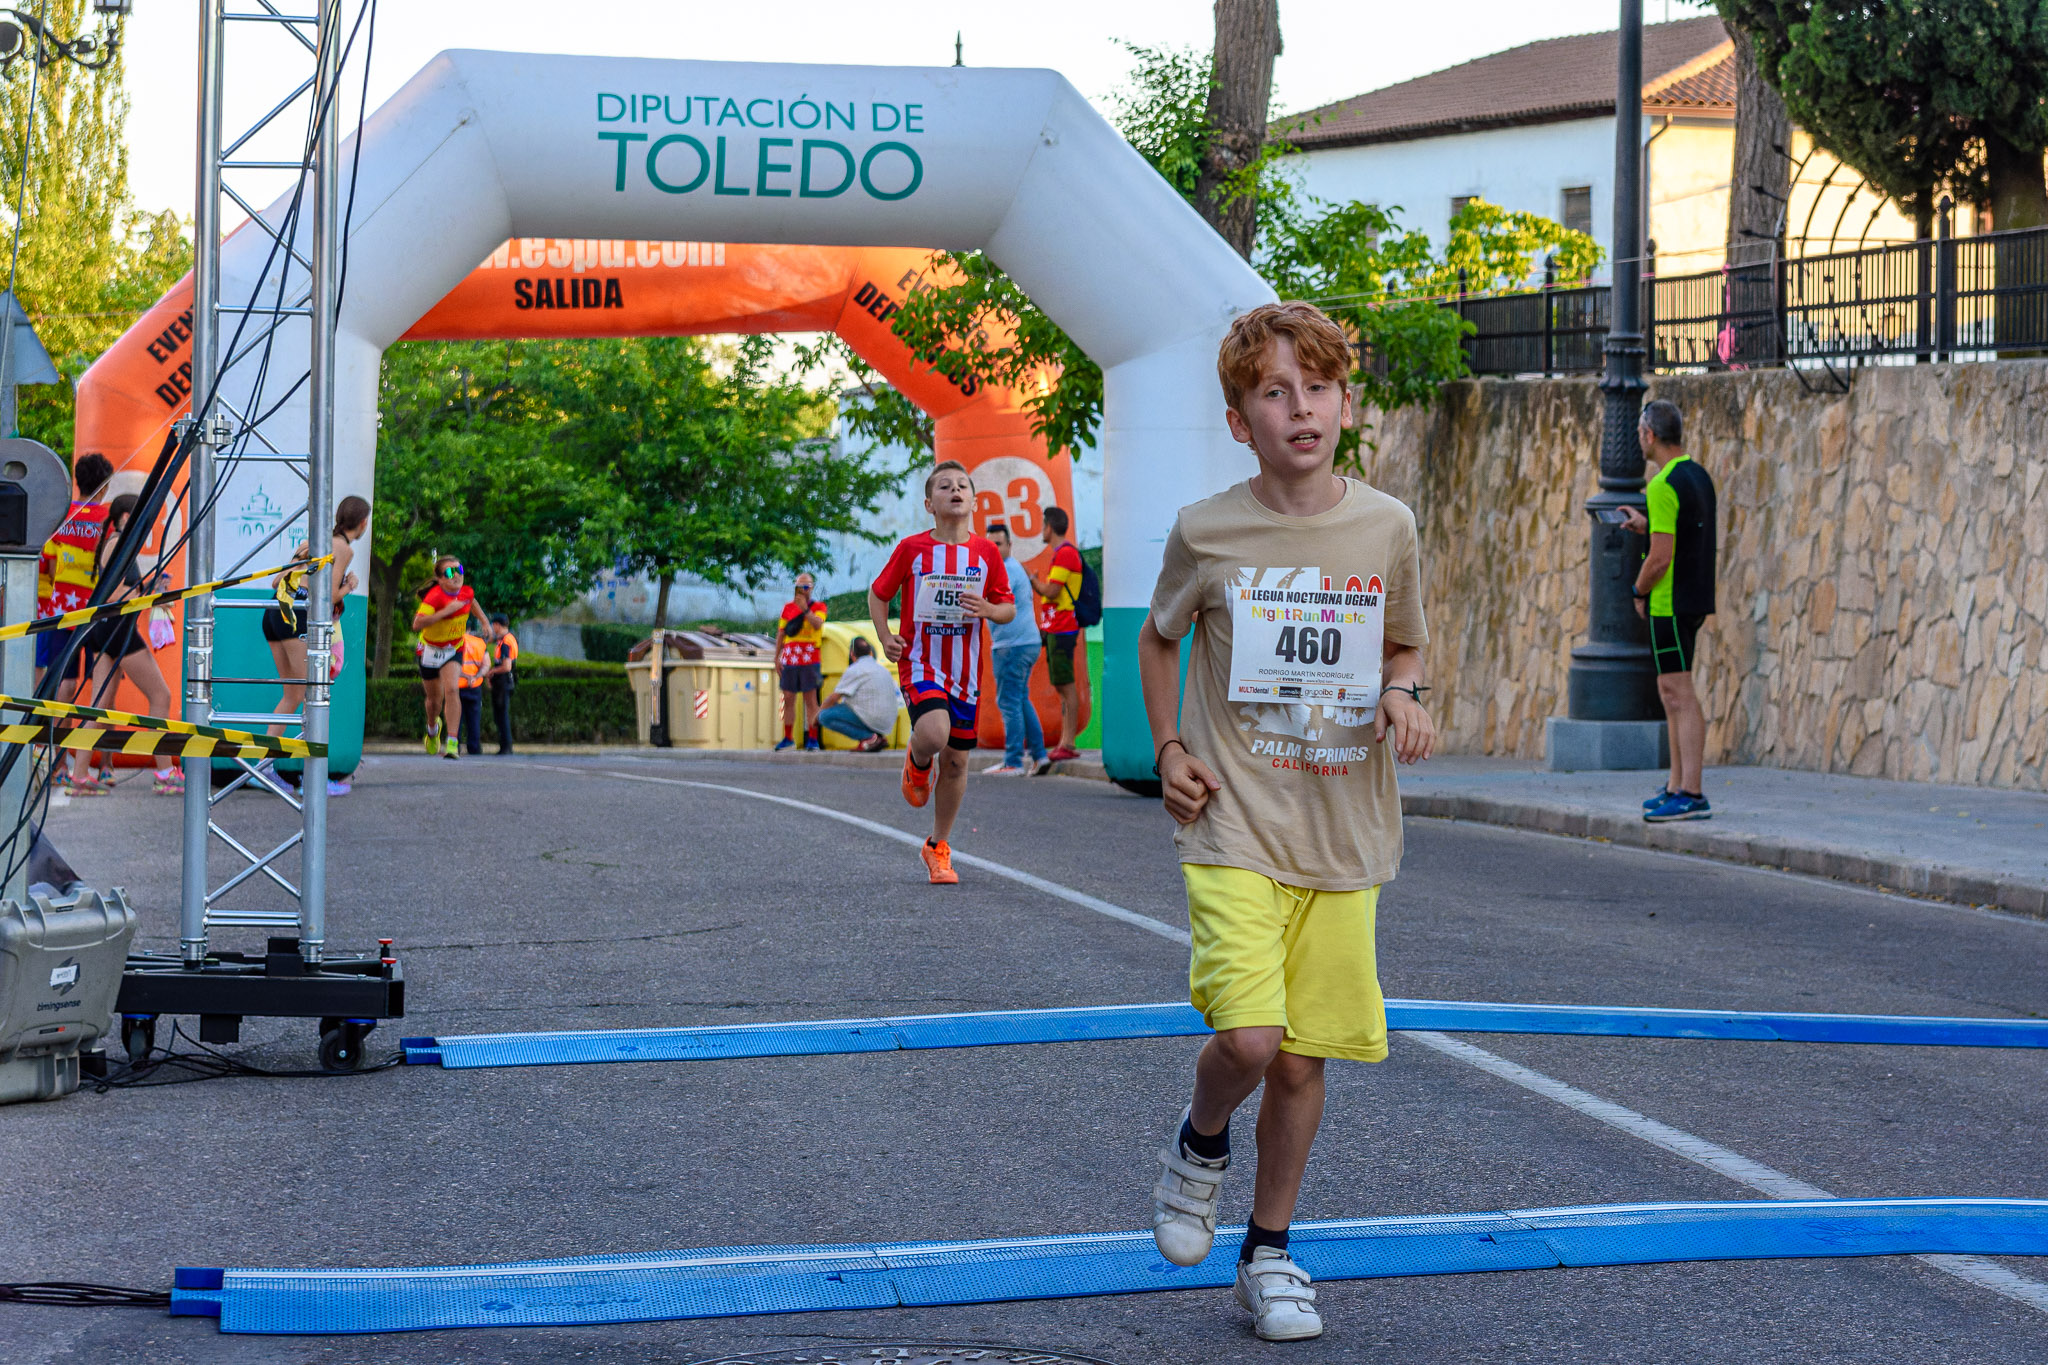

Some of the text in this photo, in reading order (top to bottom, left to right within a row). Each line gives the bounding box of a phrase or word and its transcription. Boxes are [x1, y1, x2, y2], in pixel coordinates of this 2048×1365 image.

[597, 93, 925, 133] DIPUTACIÓN DE
[598, 131, 924, 201] TOLEDO
[514, 278, 624, 310] SALIDA
[146, 303, 194, 366] EVEN
[973, 477, 1043, 539] e3
[57, 524, 103, 539] RIATLON
[934, 589, 963, 606] 455
[1240, 588, 1378, 607] XI LEGUA NOCTURNA UGENA
[1275, 625, 1342, 666] 460
[1258, 668, 1355, 680] RODRIGO MARTÍN RODRÍGUEZ
[1251, 739, 1369, 763] PALM SPRINGS
[1272, 758, 1349, 776] CALIFORNIA
[37, 1000, 81, 1012] timingsense
